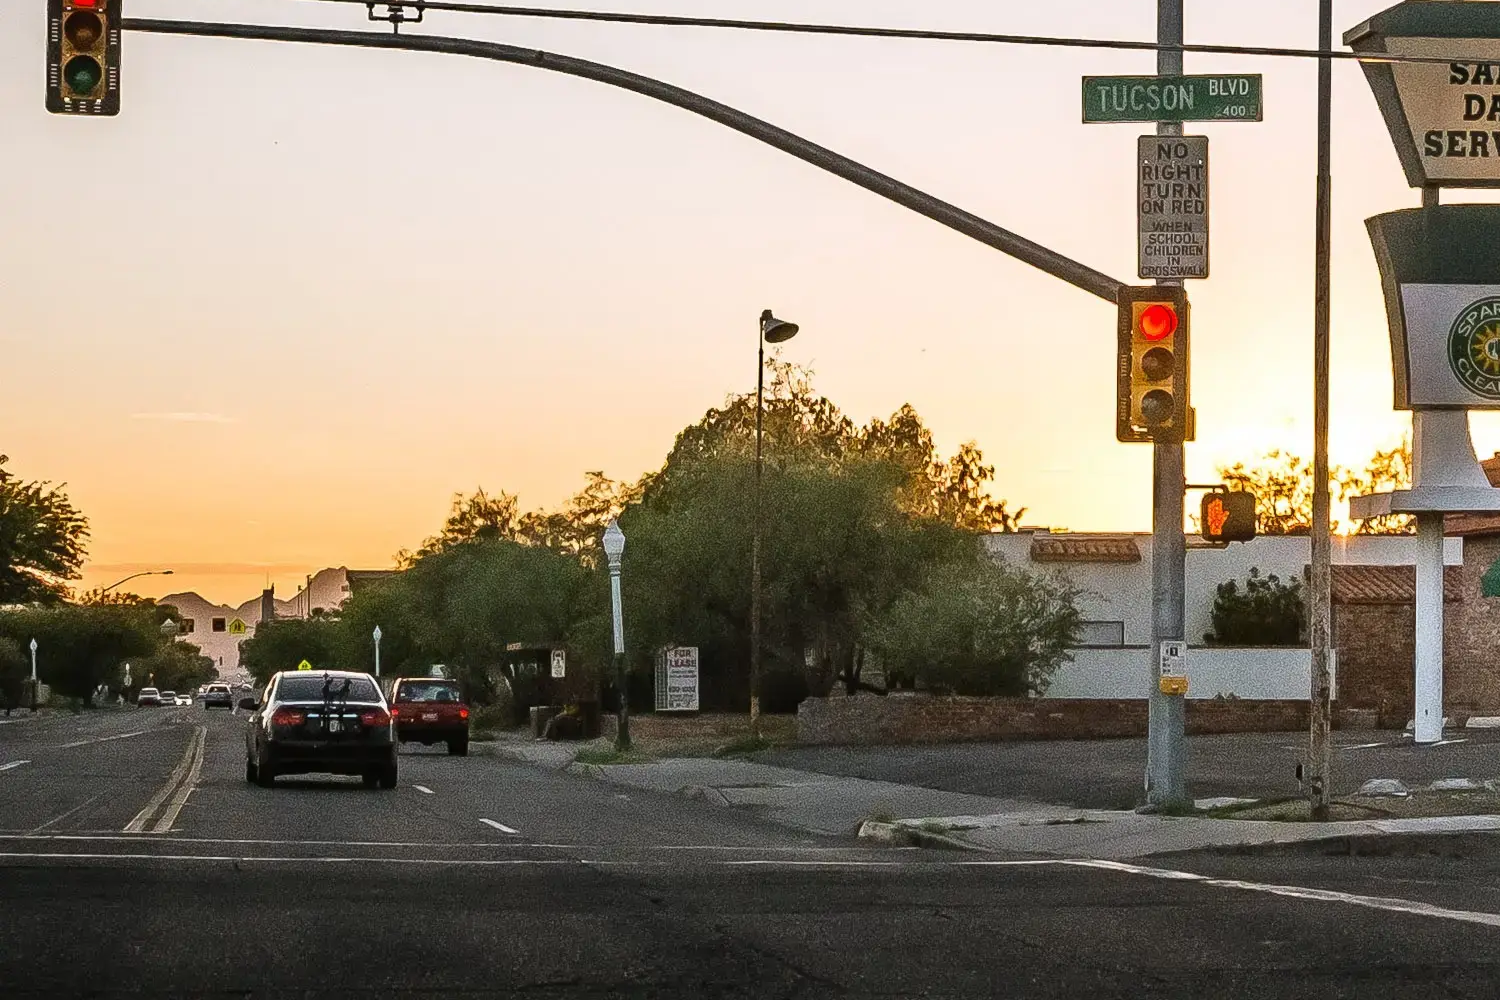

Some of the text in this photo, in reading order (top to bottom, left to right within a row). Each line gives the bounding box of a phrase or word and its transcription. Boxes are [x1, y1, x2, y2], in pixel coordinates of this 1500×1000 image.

[1097, 79, 1249, 112] TUCSON BLVD
[1157, 143, 1188, 159] NO
[1141, 165, 1203, 180] RIGHT
[1143, 183, 1201, 199] TURN
[1141, 200, 1205, 214] ON RED
[1152, 222, 1192, 232] WHEN
[1148, 234, 1199, 244] SCHOOL
[1144, 246, 1203, 256] CHILDREN
[1167, 257, 1180, 266] IN
[1141, 266, 1205, 276] CROSSWALK
[673, 649, 692, 658] FOR
